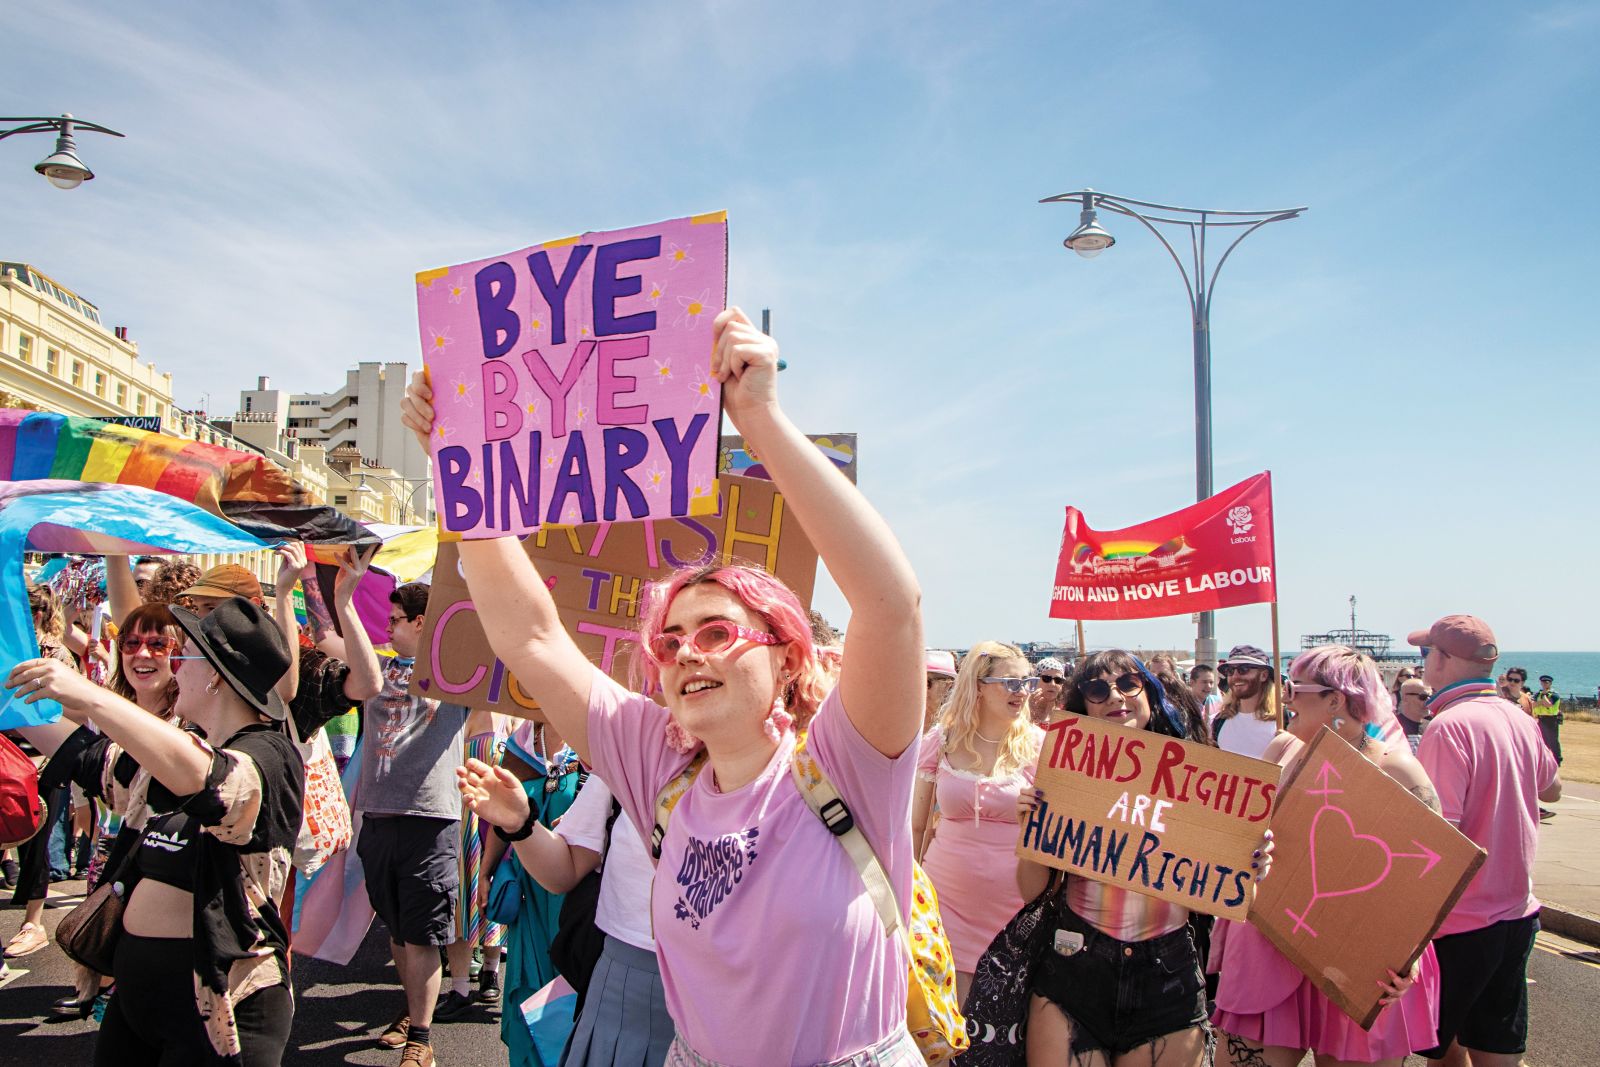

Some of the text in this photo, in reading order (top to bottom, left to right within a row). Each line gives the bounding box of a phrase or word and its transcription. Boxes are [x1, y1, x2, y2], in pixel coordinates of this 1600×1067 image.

[475, 236, 661, 358] BYE
[124, 417, 160, 430] NOW!
[481, 336, 650, 441] BYE
[438, 414, 709, 531] BINARY
[1087, 586, 1119, 602] AND
[1123, 579, 1180, 601] HOVE
[1185, 567, 1271, 593] LABOUR
[1230, 536, 1256, 545] Labour
[1047, 717, 1276, 822] TRANS RIGHTS
[1106, 792, 1173, 833] ARE
[1023, 801, 1251, 908] HUMAN RIGHTS
